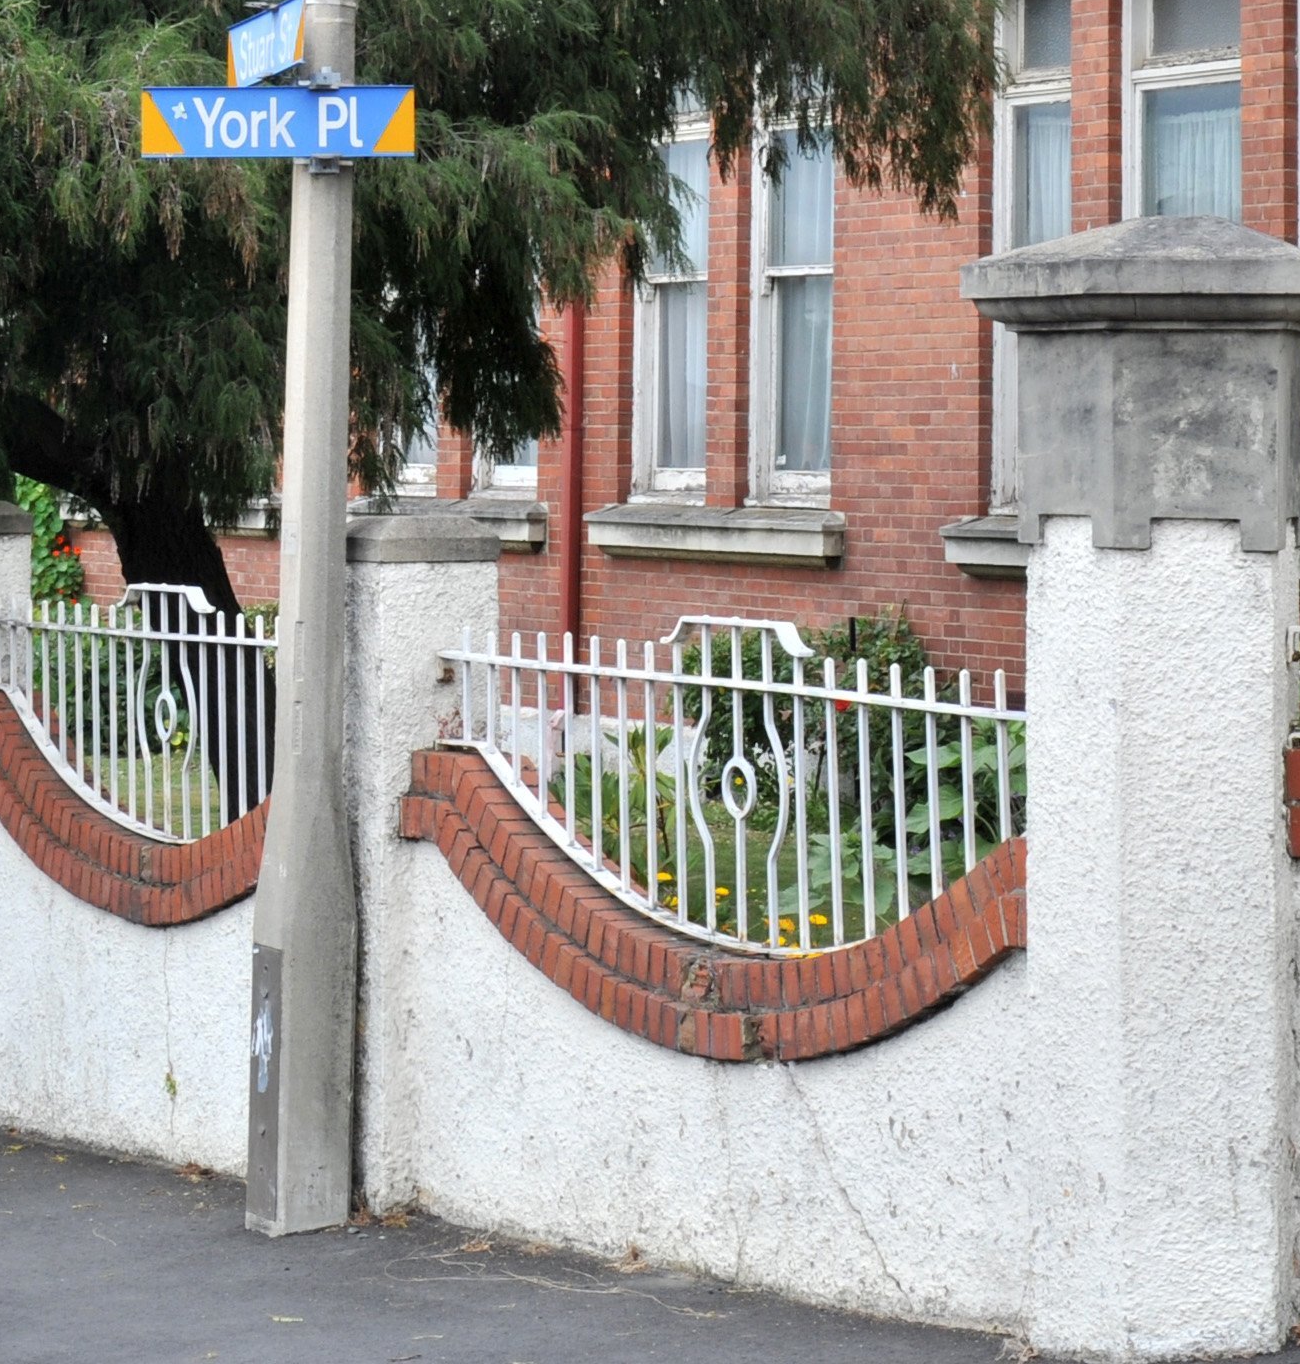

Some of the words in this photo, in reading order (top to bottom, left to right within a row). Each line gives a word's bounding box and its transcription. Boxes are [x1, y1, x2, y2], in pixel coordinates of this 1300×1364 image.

[240, 30, 276, 81] Stuart
[279, 11, 294, 65] St
[192, 96, 296, 148] York
[317, 96, 364, 148] Pl
